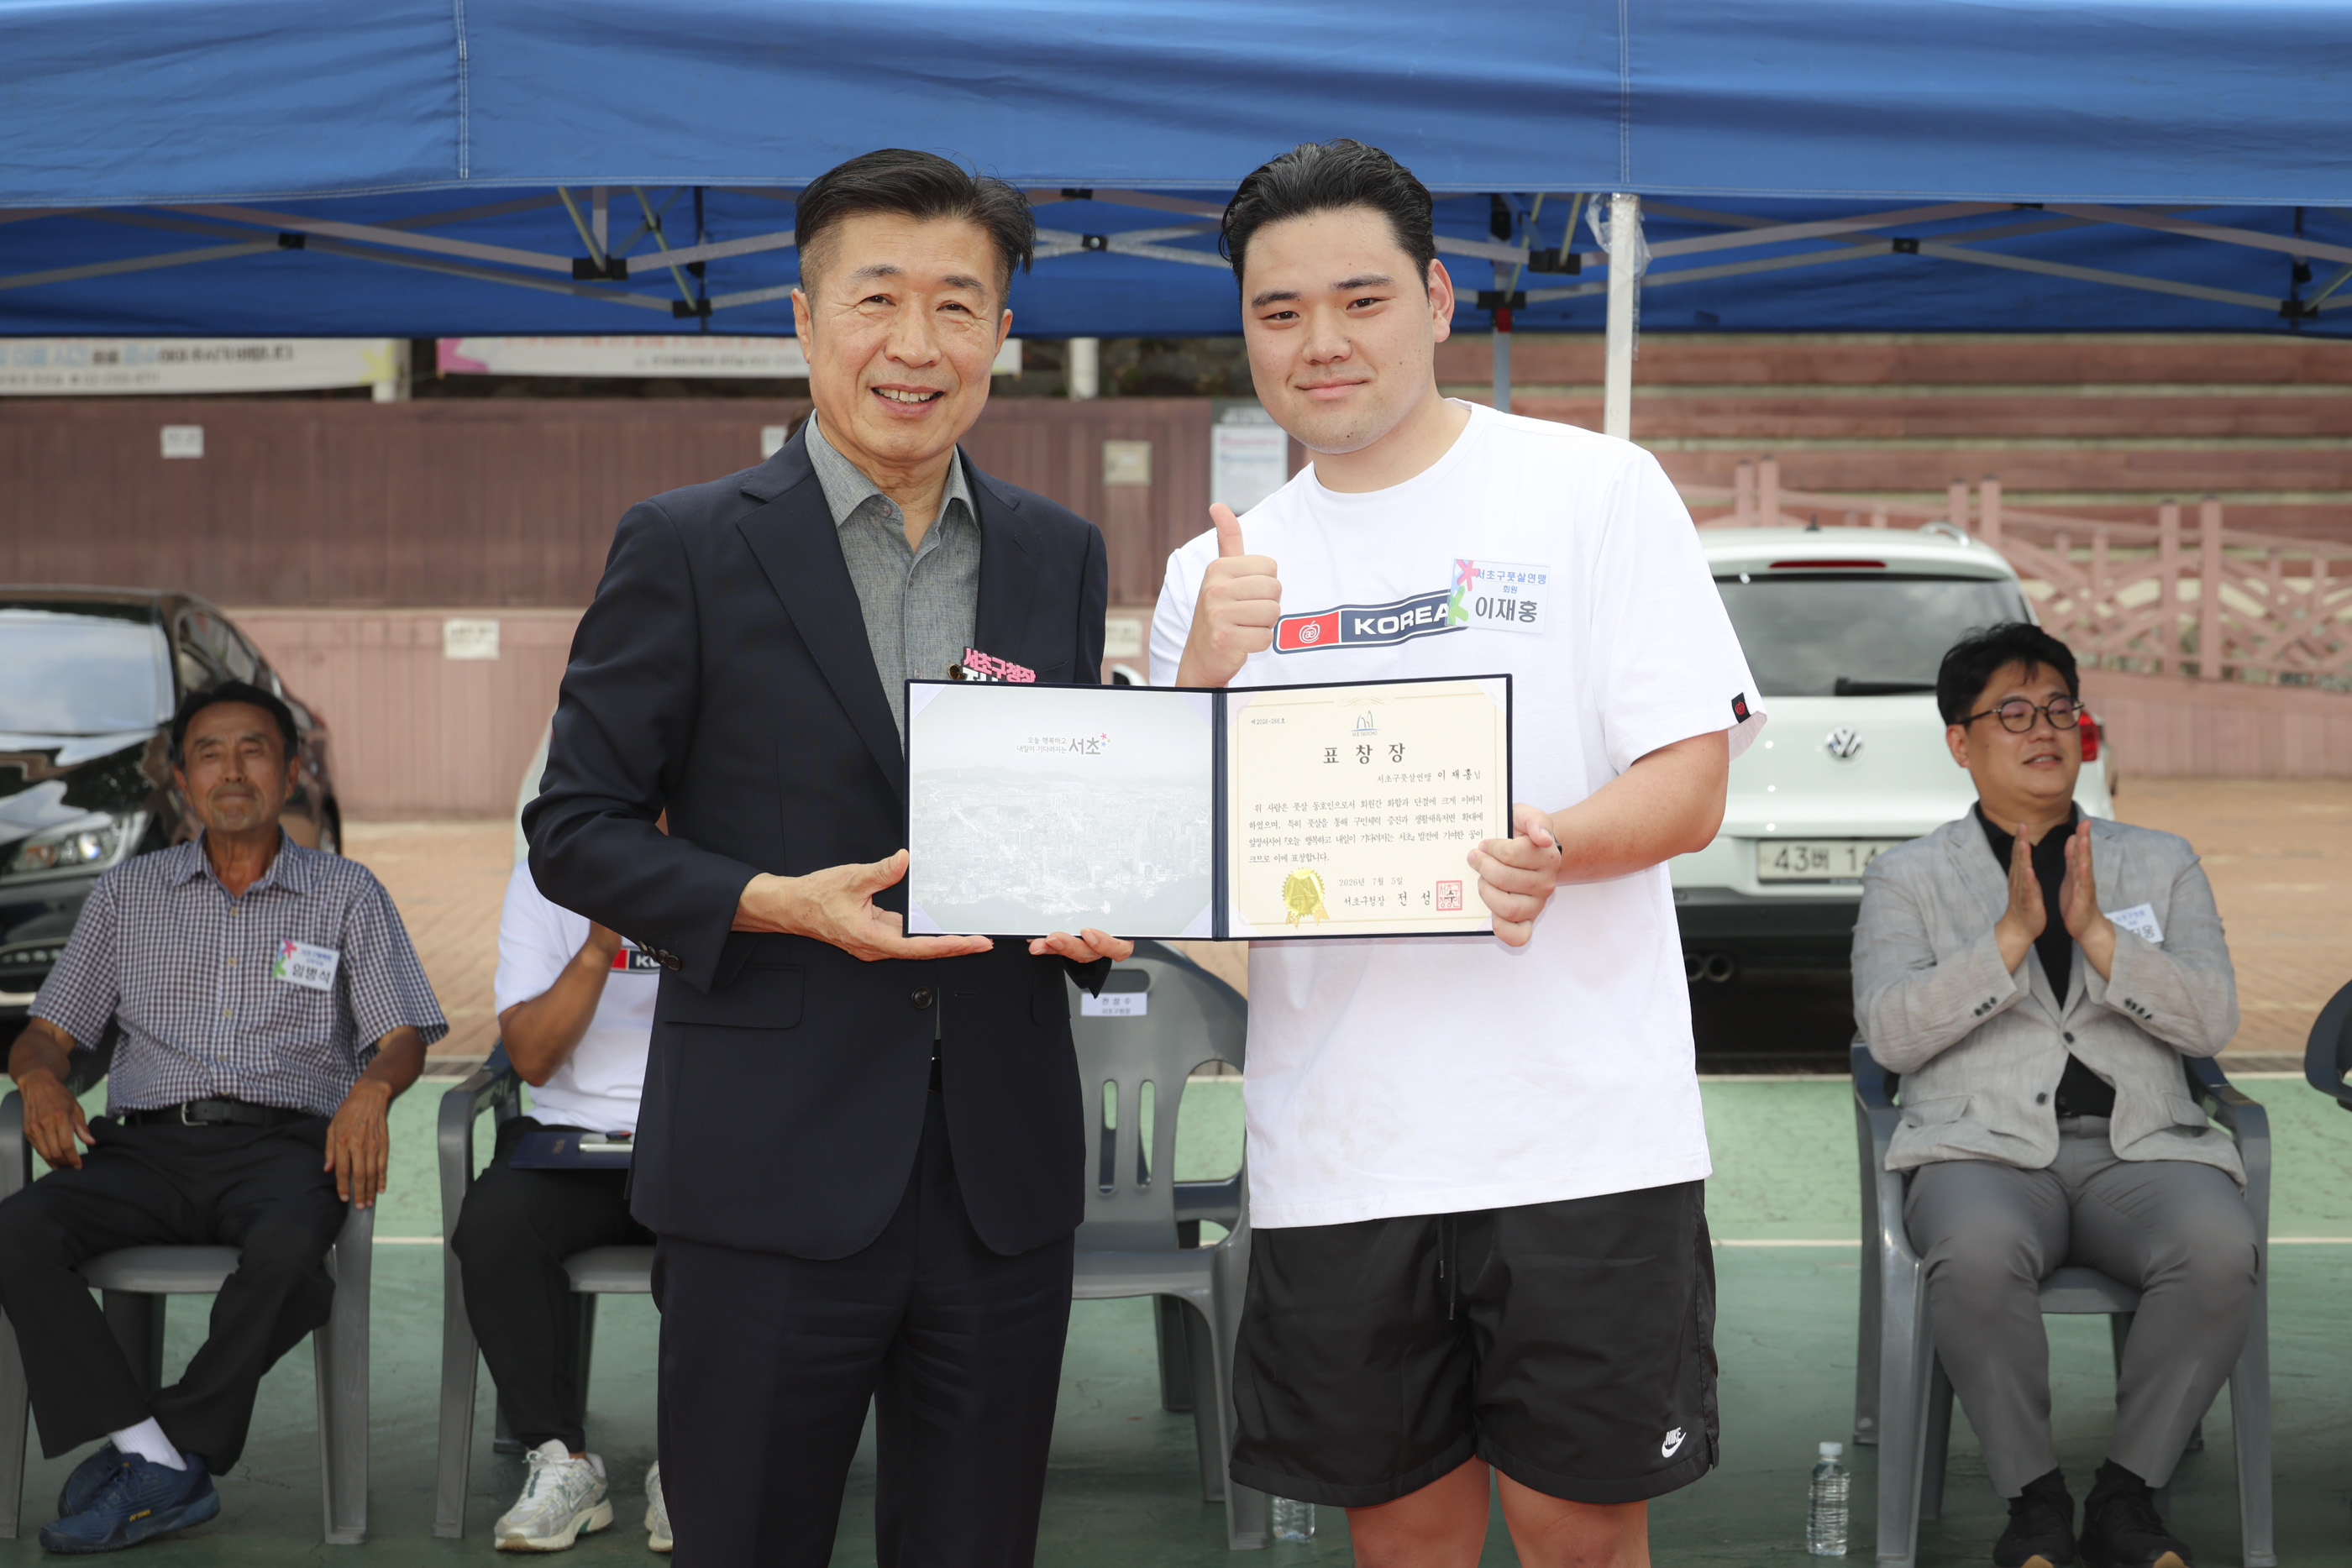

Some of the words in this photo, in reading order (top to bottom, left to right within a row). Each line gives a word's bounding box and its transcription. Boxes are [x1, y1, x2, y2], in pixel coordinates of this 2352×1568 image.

[1476, 569, 1546, 585] 서초구풋살연맹
[1503, 585, 1518, 594] 회원
[1475, 596, 1537, 623] 이재홍
[1354, 603, 1449, 635] KOREA
[963, 648, 1036, 683] 서초구청장
[1042, 737, 1067, 745] 행복하고
[1068, 737, 1100, 755] 서초
[1377, 772, 1431, 784] 서초구풋살연맹
[1254, 803, 1262, 813] 위
[1267, 803, 1289, 813] 사람은
[1294, 802, 1308, 812] 풋살
[1313, 800, 1355, 811] 동호인으로서
[1360, 799, 1383, 809] 회원간
[1387, 798, 1409, 808] 화합과
[1414, 796, 1436, 807] 단결에
[1441, 795, 1457, 805] 크게
[1461, 794, 1483, 805] 이바지
[1249, 820, 1281, 831] 하였으며,
[1288, 819, 1301, 829] 특히
[1307, 818, 1328, 828] 풋살을
[1333, 817, 1348, 827] 통해
[1353, 815, 1381, 826] 구민체력
[1387, 815, 1408, 826] 증진과
[1415, 813, 1456, 825] 생활체육저변
[1462, 812, 1483, 822] 확대에
[1305, 835, 1331, 846] 행복하고
[1336, 833, 1356, 844] 내일이
[1361, 832, 1394, 843] 기다려지는
[1418, 831, 1439, 842] 발전에
[1443, 830, 1464, 840] 기여한
[1469, 829, 1483, 840] 공이
[1273, 853, 1289, 863] 이에
[1291, 852, 1330, 863] 표창합니다.
[1339, 878, 1365, 887] 2026년
[1372, 877, 1384, 886] 7월
[1391, 876, 1404, 885] 5일
[1343, 896, 1385, 907] 서초구청장
